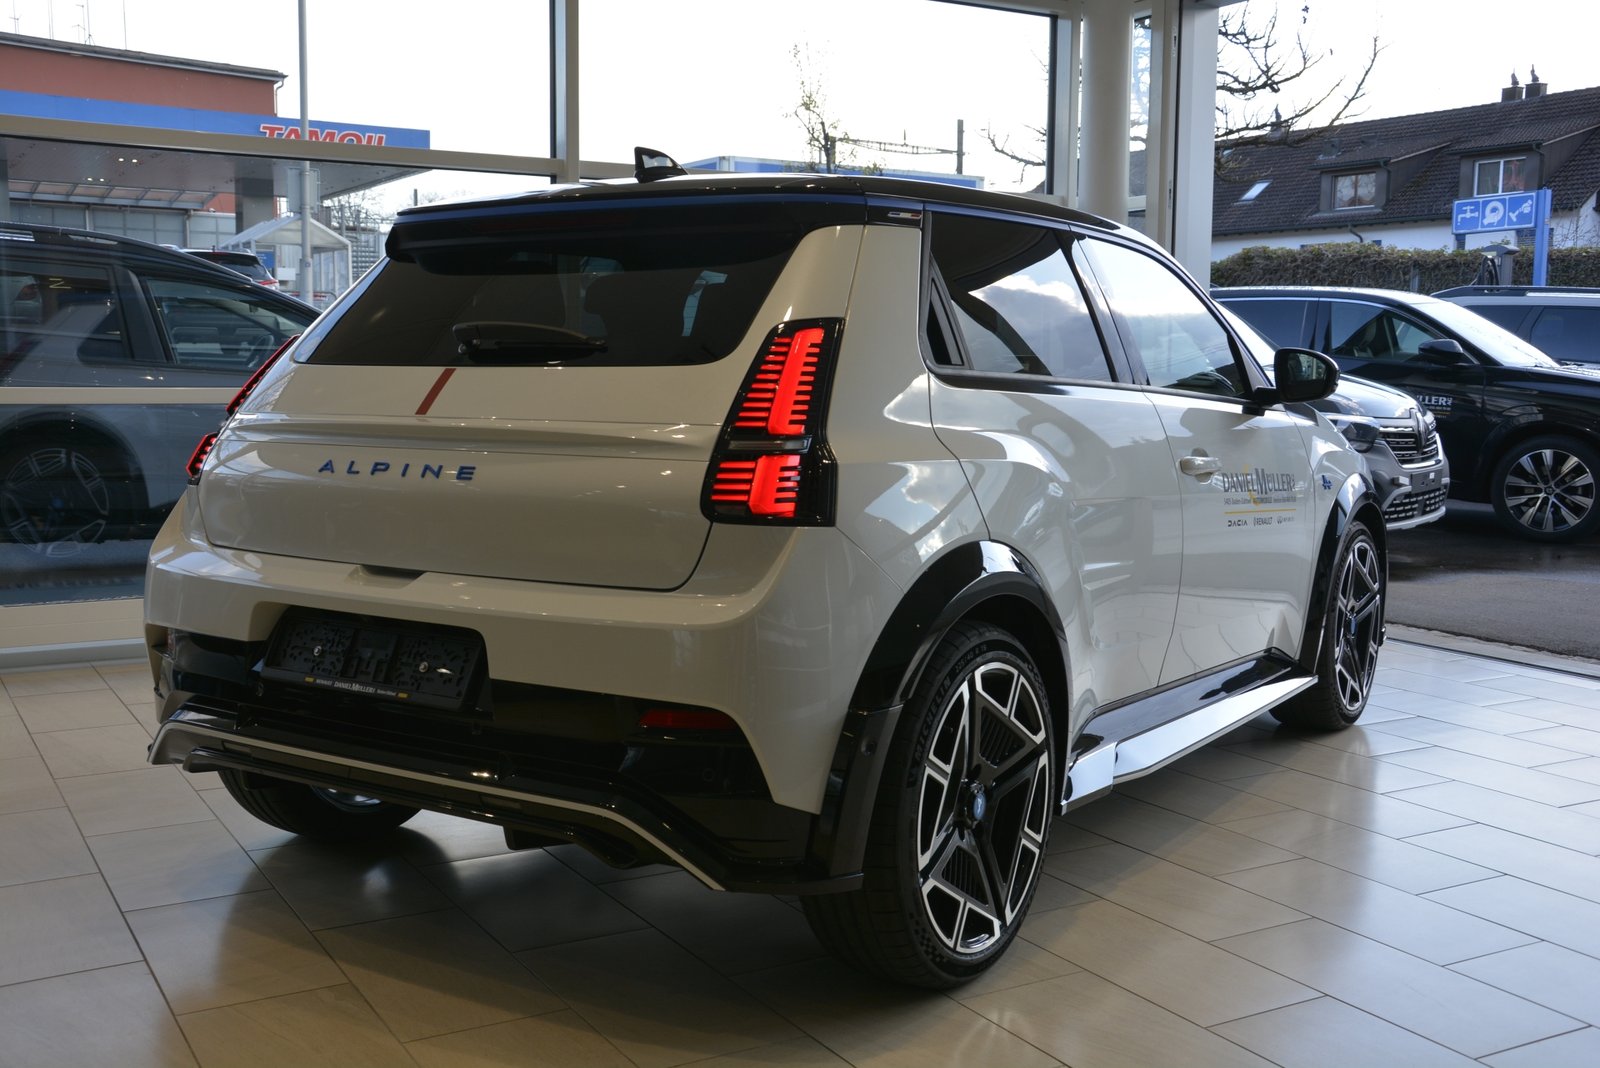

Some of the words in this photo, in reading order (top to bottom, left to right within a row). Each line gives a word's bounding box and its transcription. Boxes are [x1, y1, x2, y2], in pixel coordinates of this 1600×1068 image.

[318, 459, 476, 481] ALPINE
[1227, 519, 1249, 527] DACIA
[914, 677, 951, 762] MICHELIN
